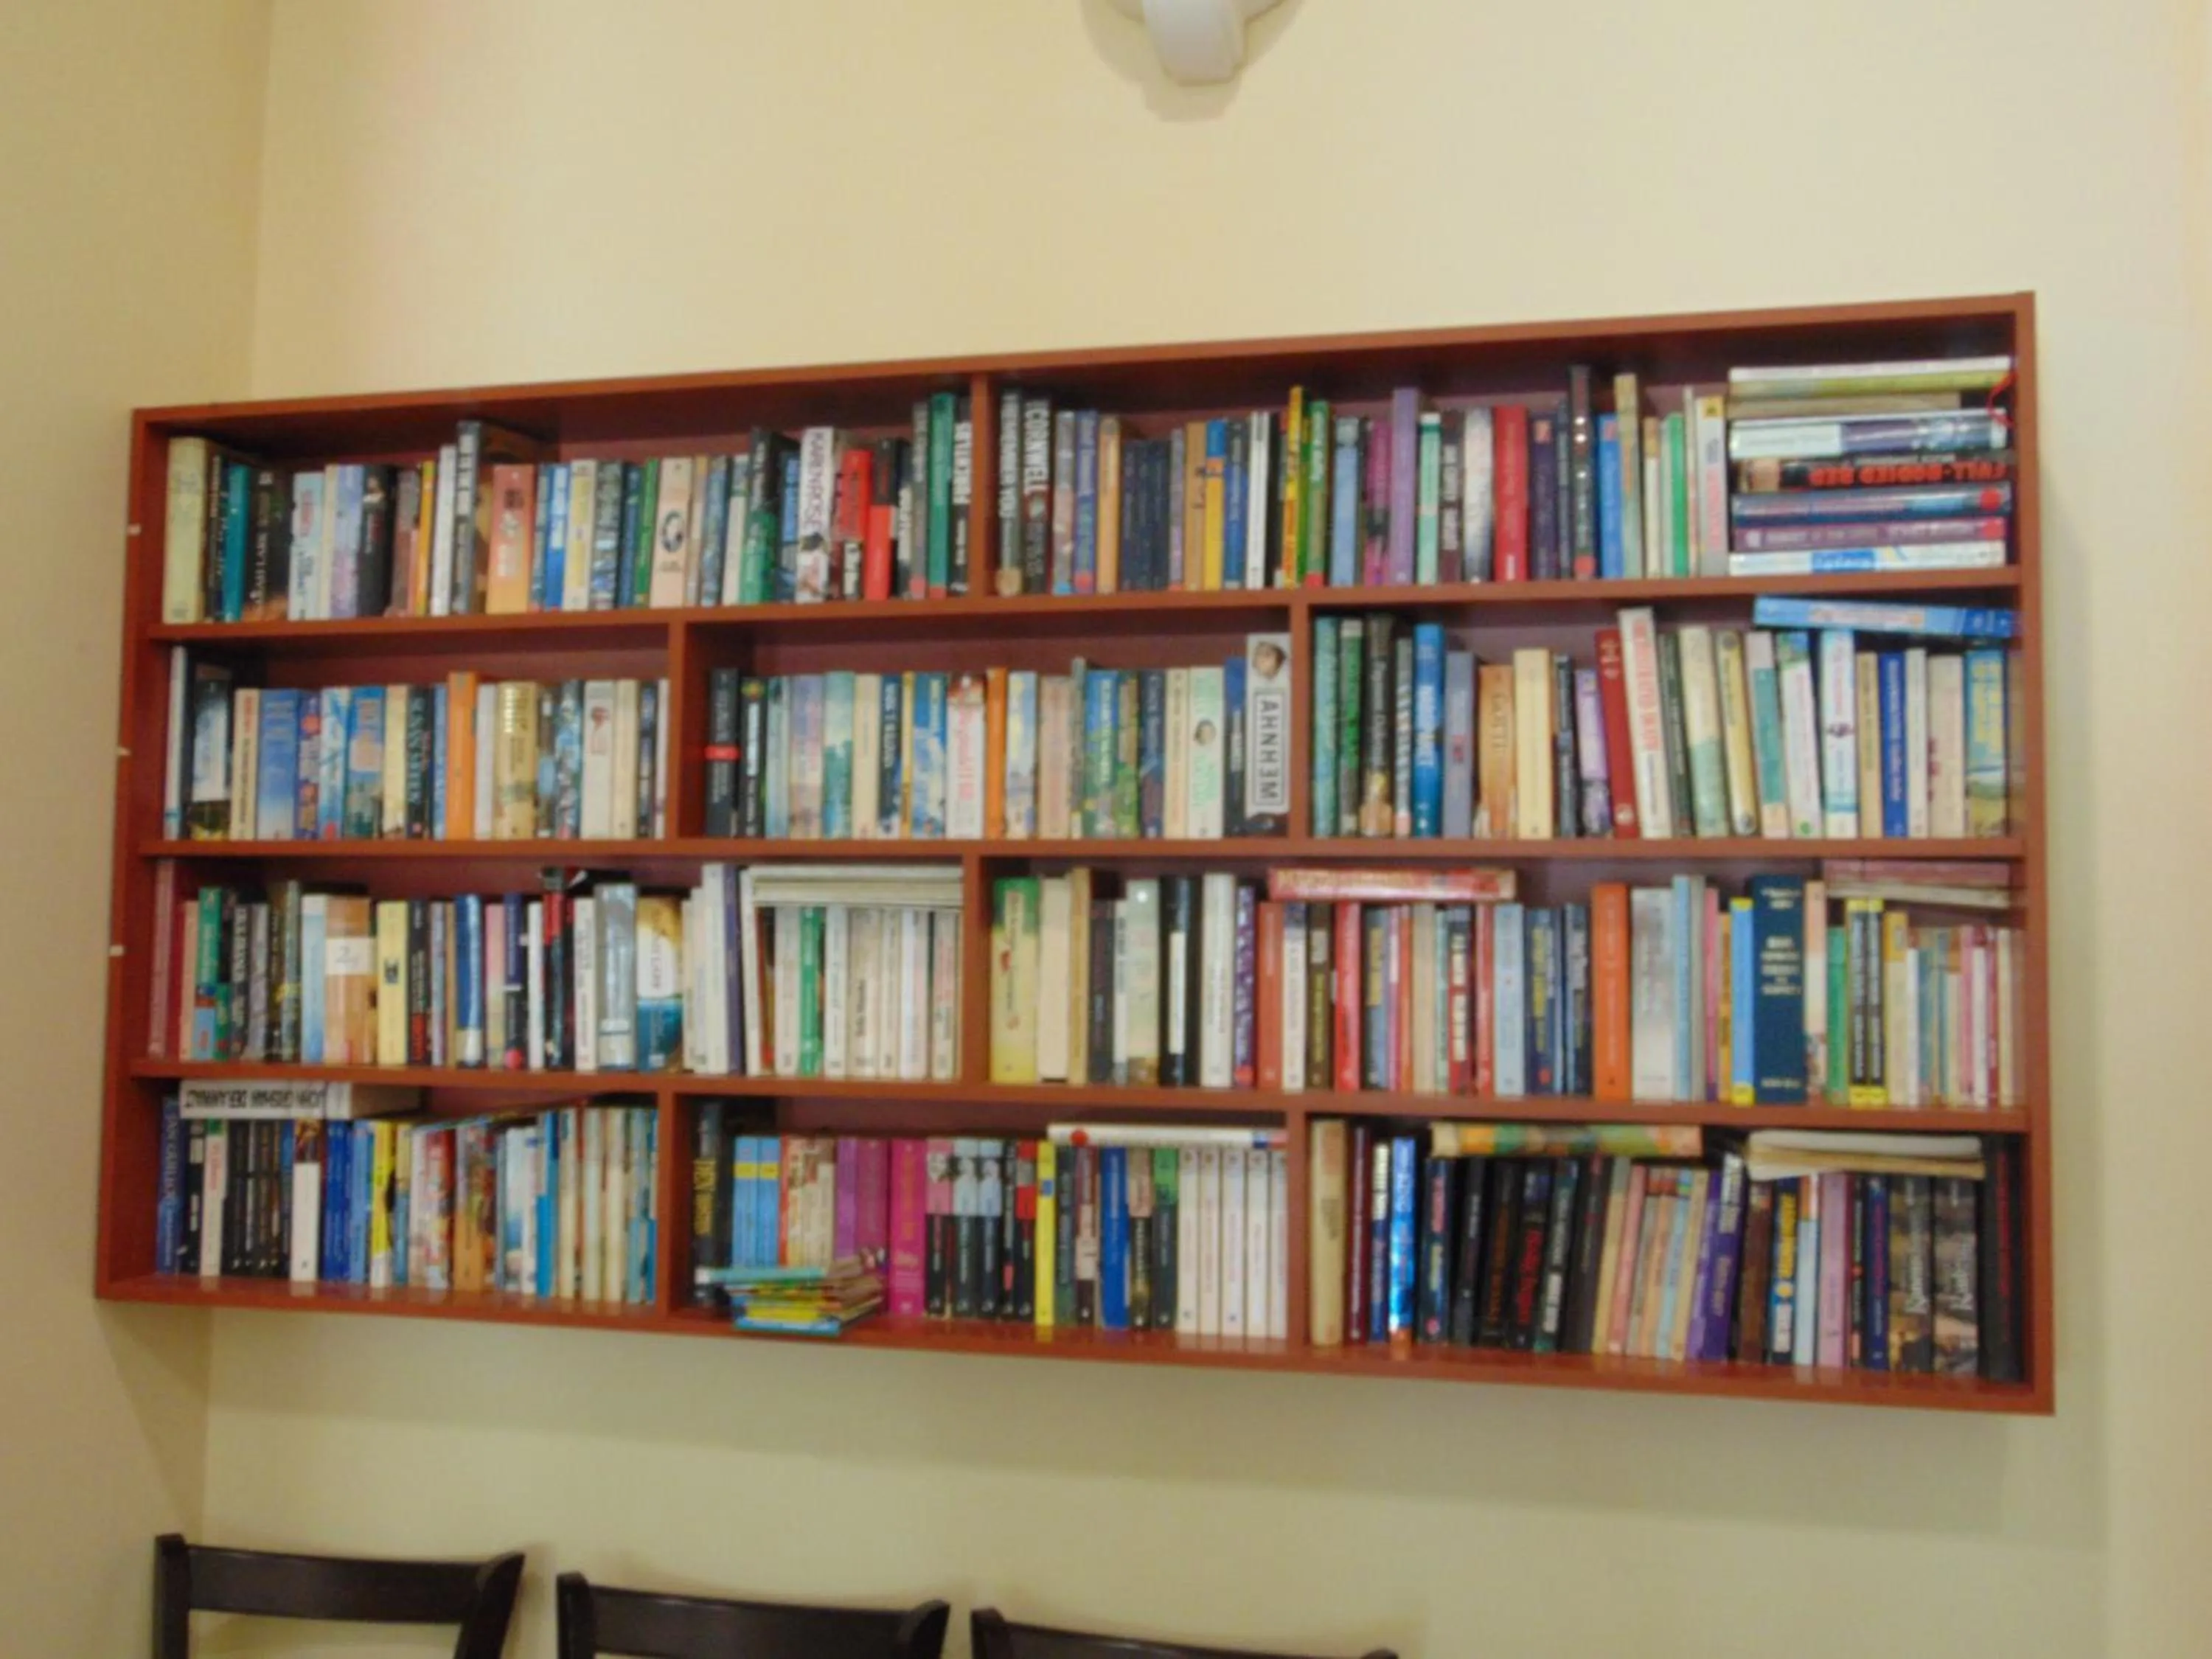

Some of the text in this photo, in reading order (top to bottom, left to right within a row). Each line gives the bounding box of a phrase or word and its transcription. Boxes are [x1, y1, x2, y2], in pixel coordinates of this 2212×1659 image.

[806, 431, 827, 530] KAREN ROSE
[1025, 408, 1050, 495] CORNWELL
[1260, 699, 1281, 799] AHNHEM
